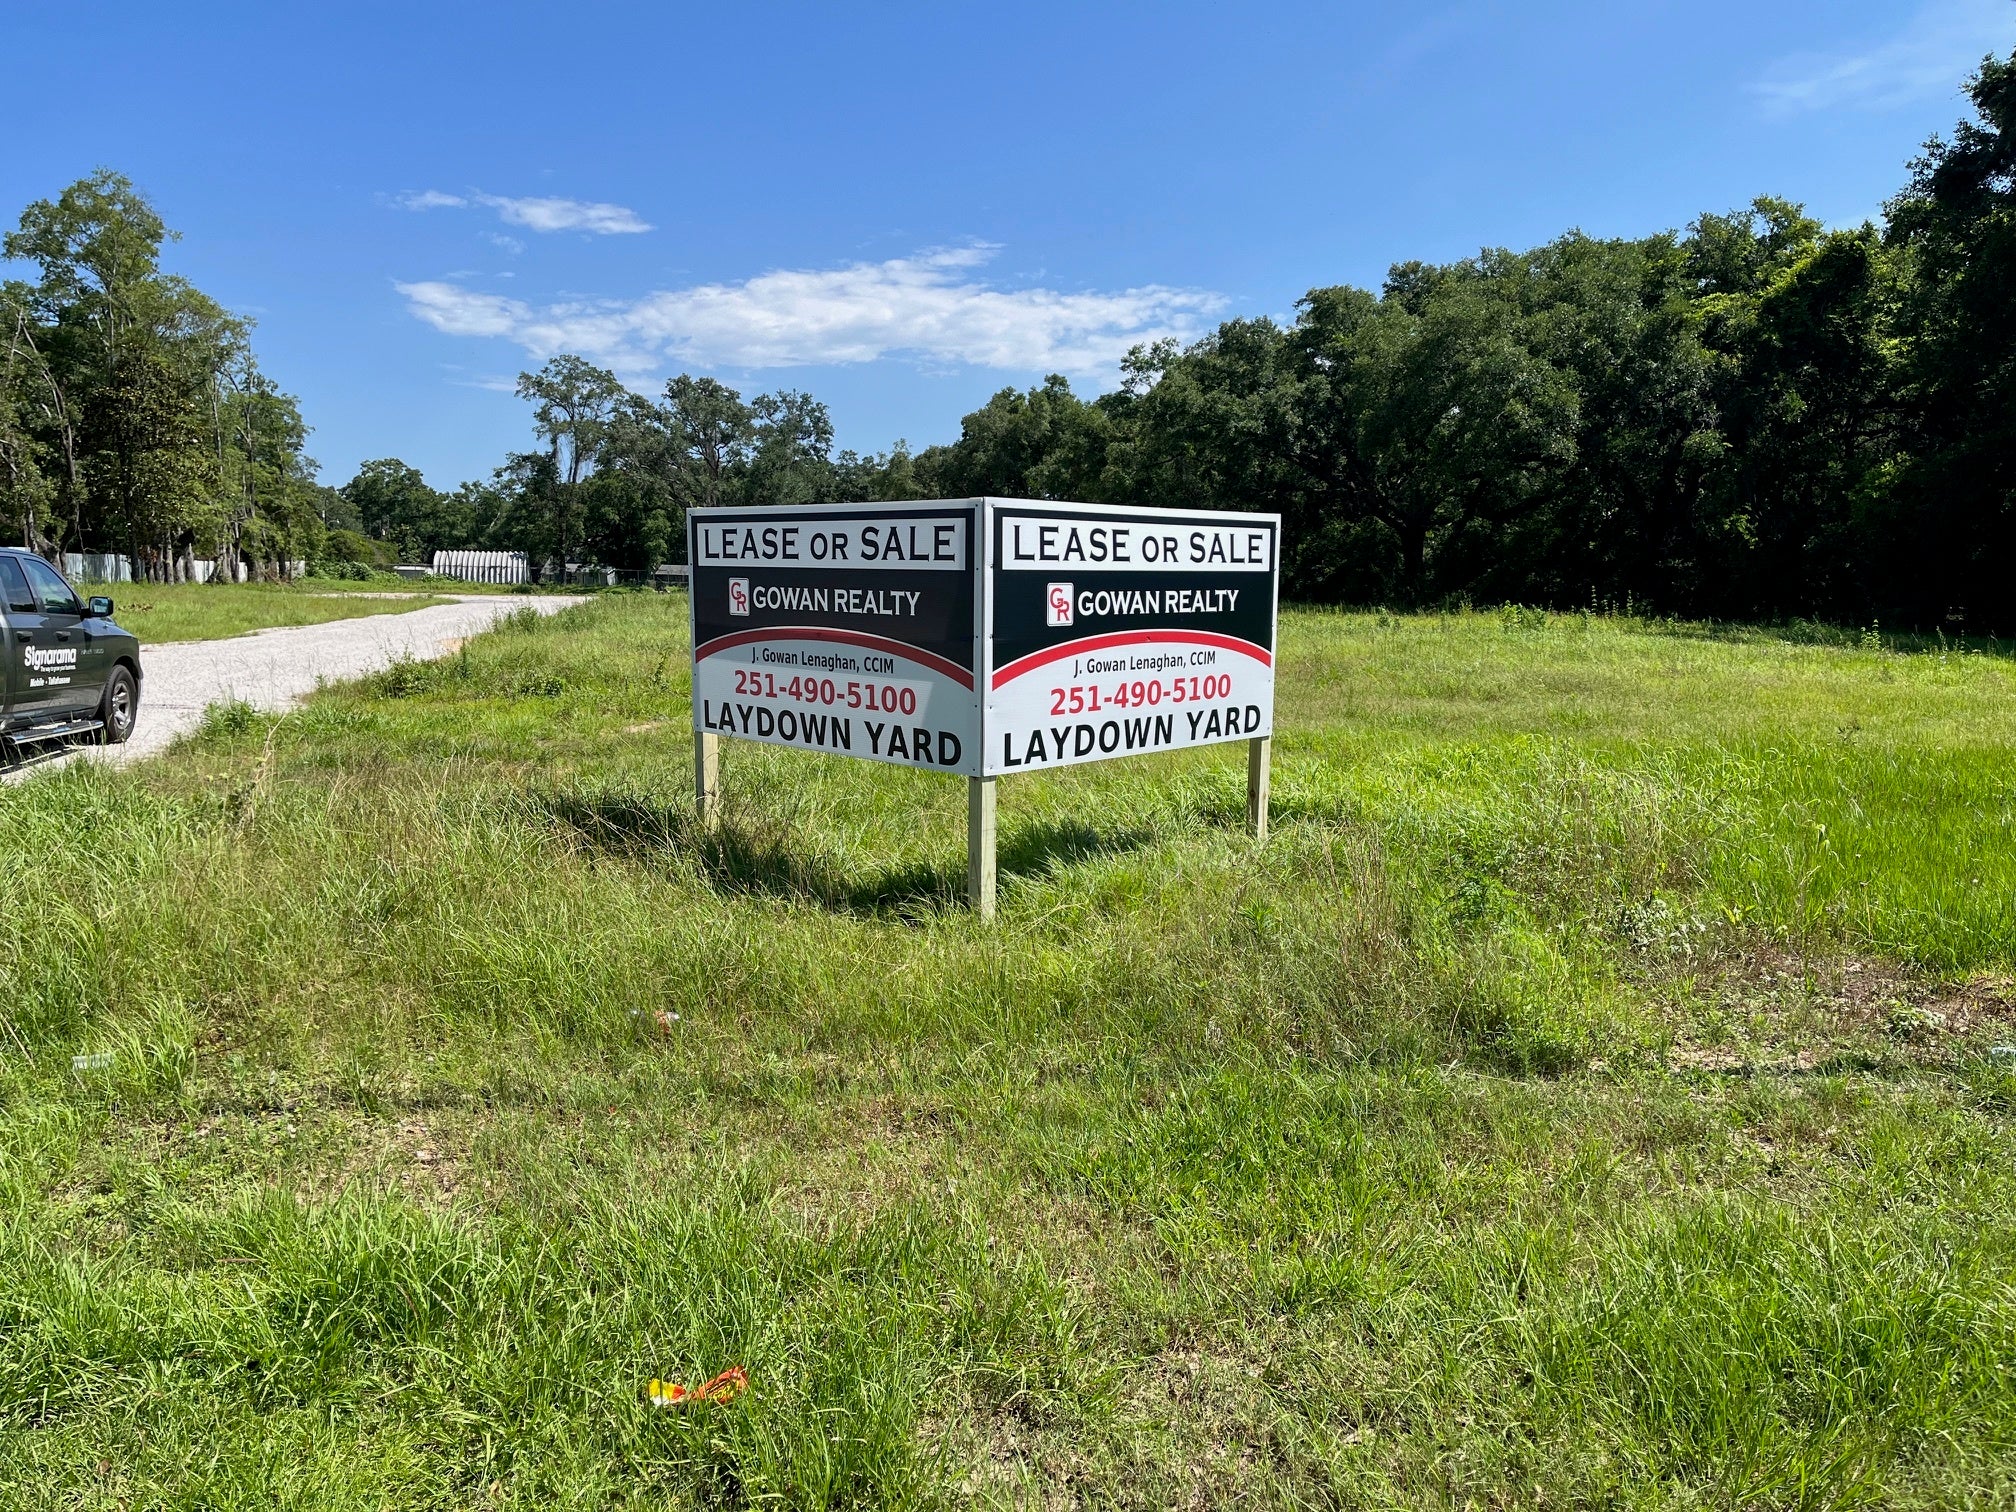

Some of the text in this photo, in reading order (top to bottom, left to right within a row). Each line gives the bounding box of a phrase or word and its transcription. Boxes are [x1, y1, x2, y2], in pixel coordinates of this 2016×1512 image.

[704, 525, 956, 562] LEASE OR SALE
[1013, 525, 1263, 564] LEASE OR SALE
[753, 586, 920, 616] GOWAN REALTY
[1078, 589, 1239, 616] GOWAN REALTY
[24, 645, 77, 671] Signarama
[751, 647, 894, 674] J. Gowan Lenaghan, CCIM
[1074, 650, 1216, 678] J. Gowan Lenaghan, CCIM
[734, 670, 916, 716] 251-490-5100
[1050, 673, 1231, 716] 251-490-5100
[703, 699, 962, 766] LAYDOWN YARD
[1004, 704, 1261, 767] LAYDOWN YARD
